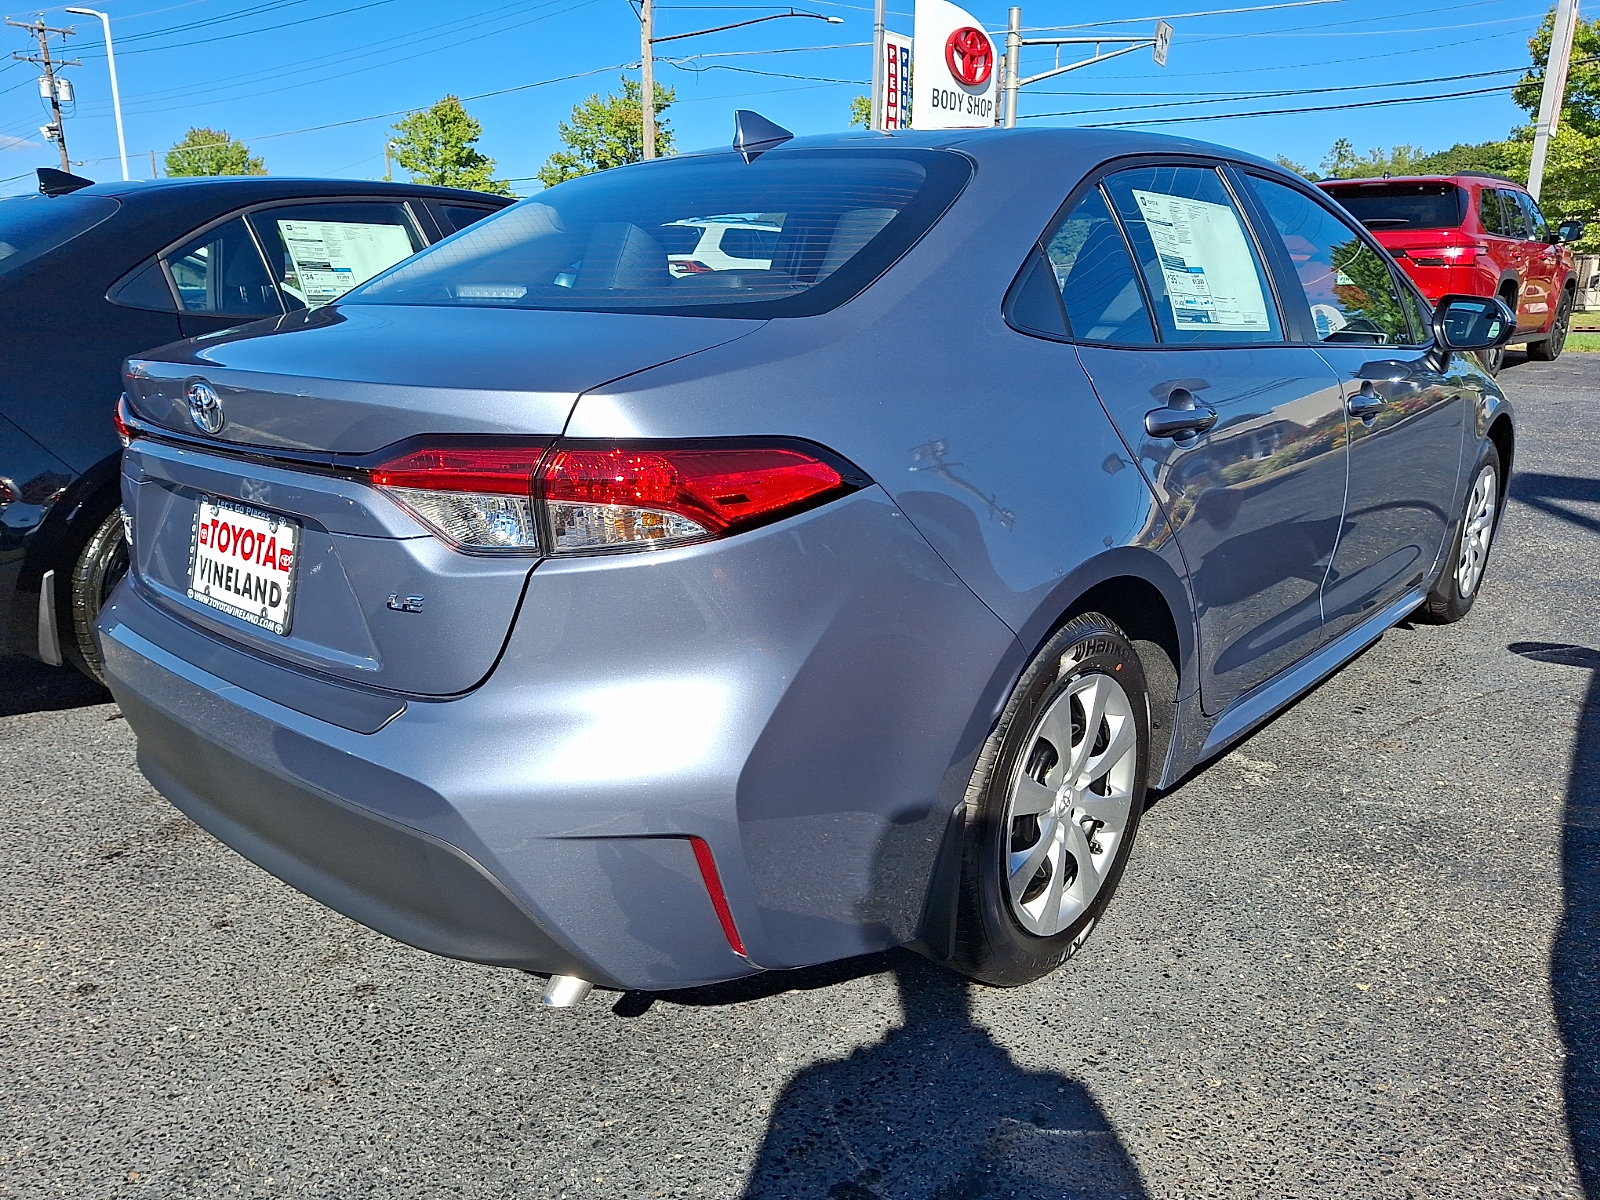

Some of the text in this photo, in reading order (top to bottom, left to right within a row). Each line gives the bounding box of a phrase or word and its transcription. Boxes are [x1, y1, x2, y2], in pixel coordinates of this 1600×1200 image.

[932, 88, 993, 118] BODY SHOP
[234, 504, 244, 513] Go
[246, 506, 270, 521] Places
[210, 518, 277, 570] TOYOTA
[200, 555, 282, 608] VINELAND
[194, 591, 275, 631] WWW.TOYOTAVINELAND.COM
[387, 593, 424, 614] LE
